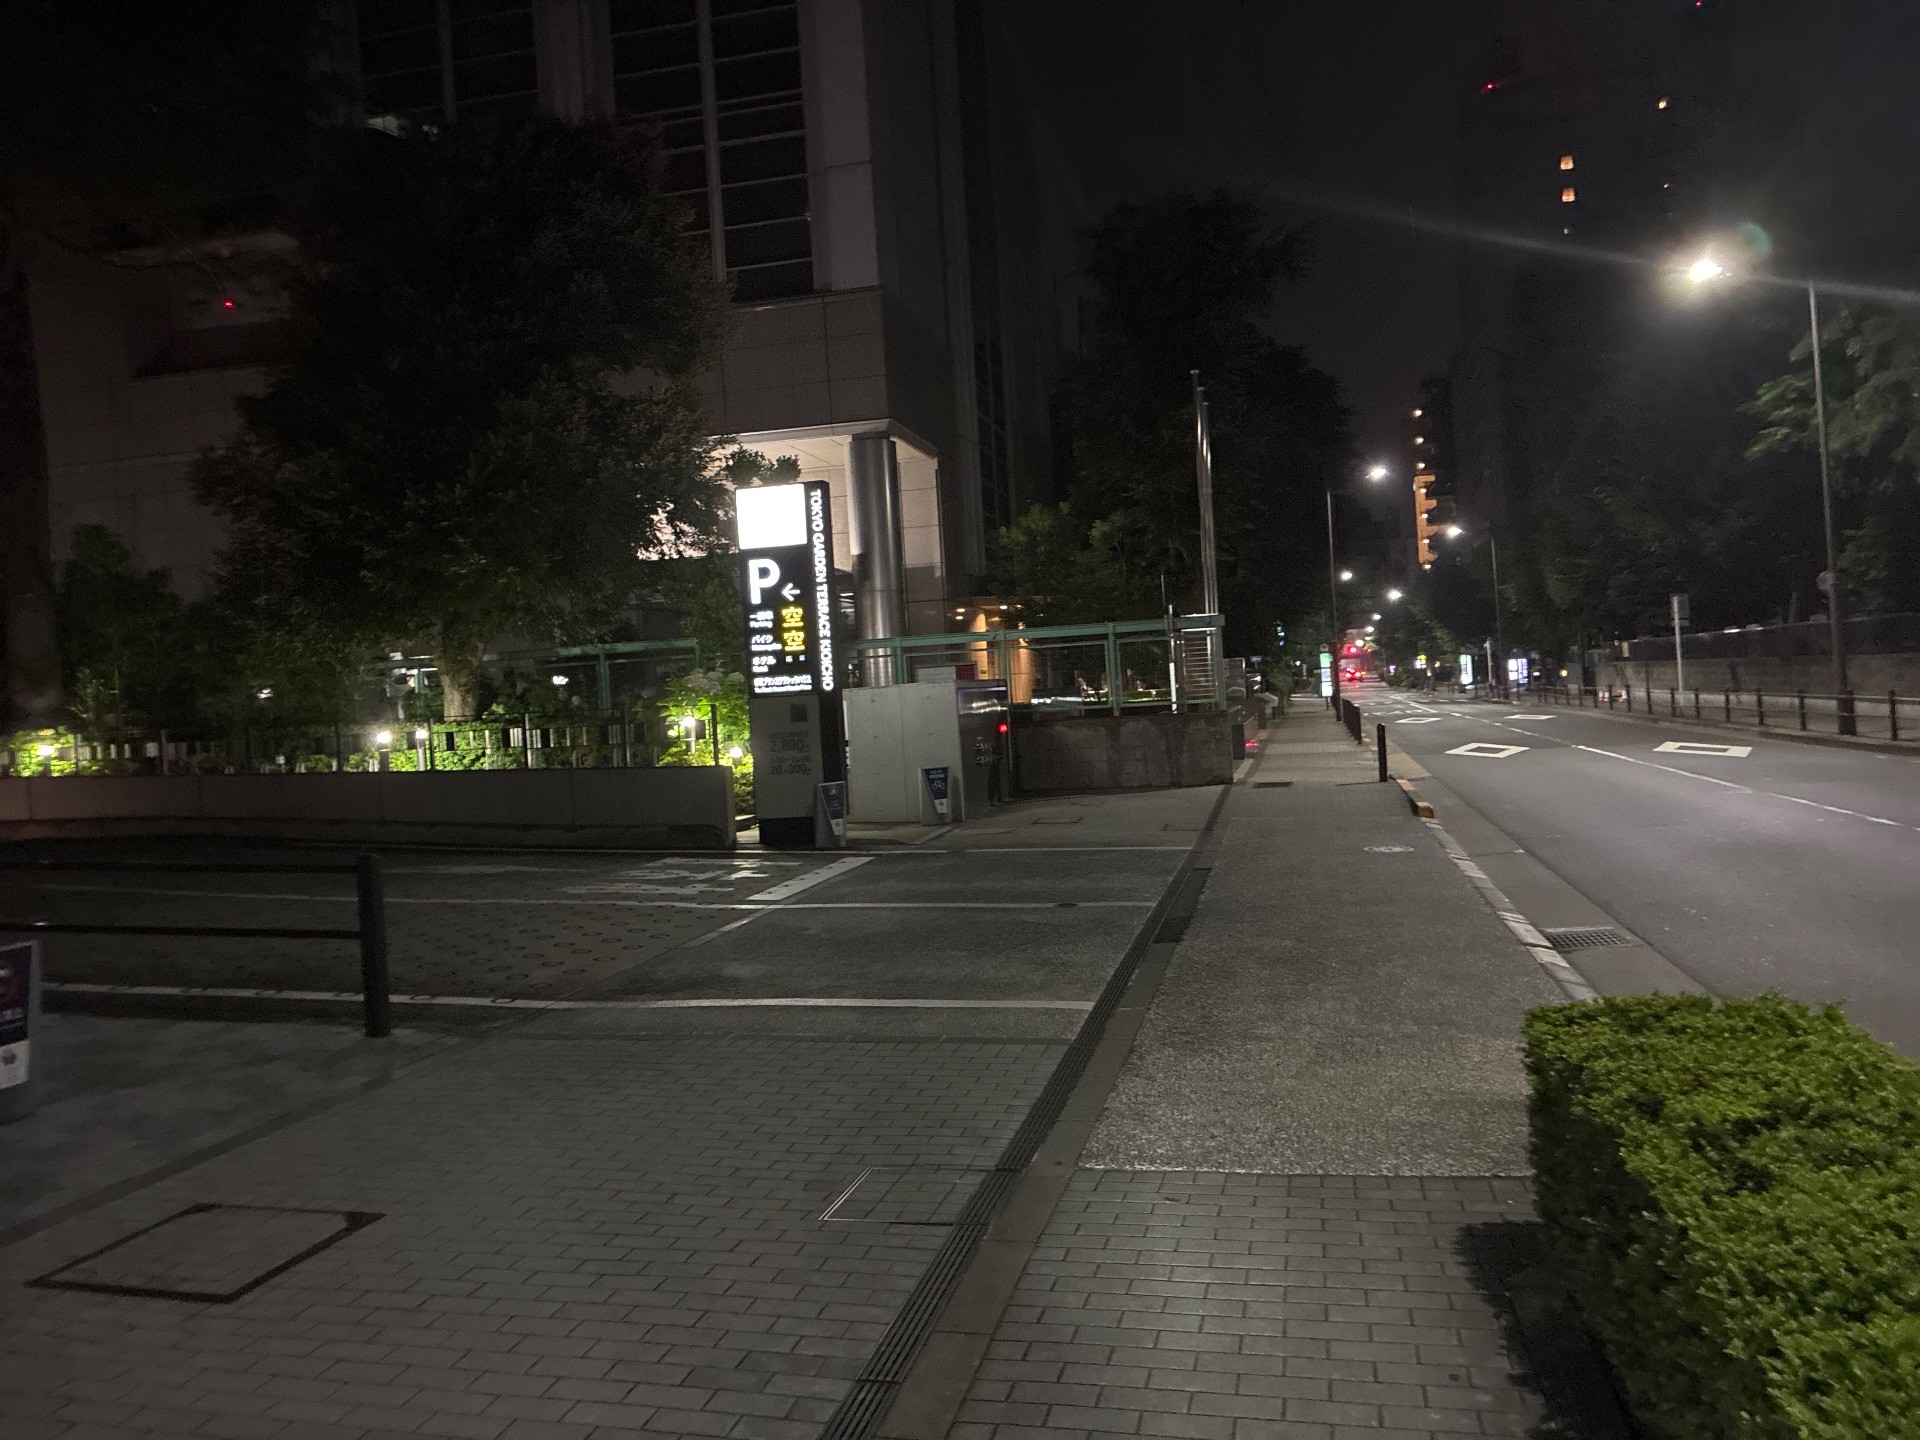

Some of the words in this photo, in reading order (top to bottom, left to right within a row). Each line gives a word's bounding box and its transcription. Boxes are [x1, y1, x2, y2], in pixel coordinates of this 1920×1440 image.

[810, 489, 824, 532] TOKYO
[812, 532, 828, 583] GARDEN
[748, 558, 781, 605] P
[781, 606, 804, 628] 空
[816, 584, 831, 638] TERRACE
[783, 630, 806, 652] 空
[819, 639, 834, 691] KIOICHO
